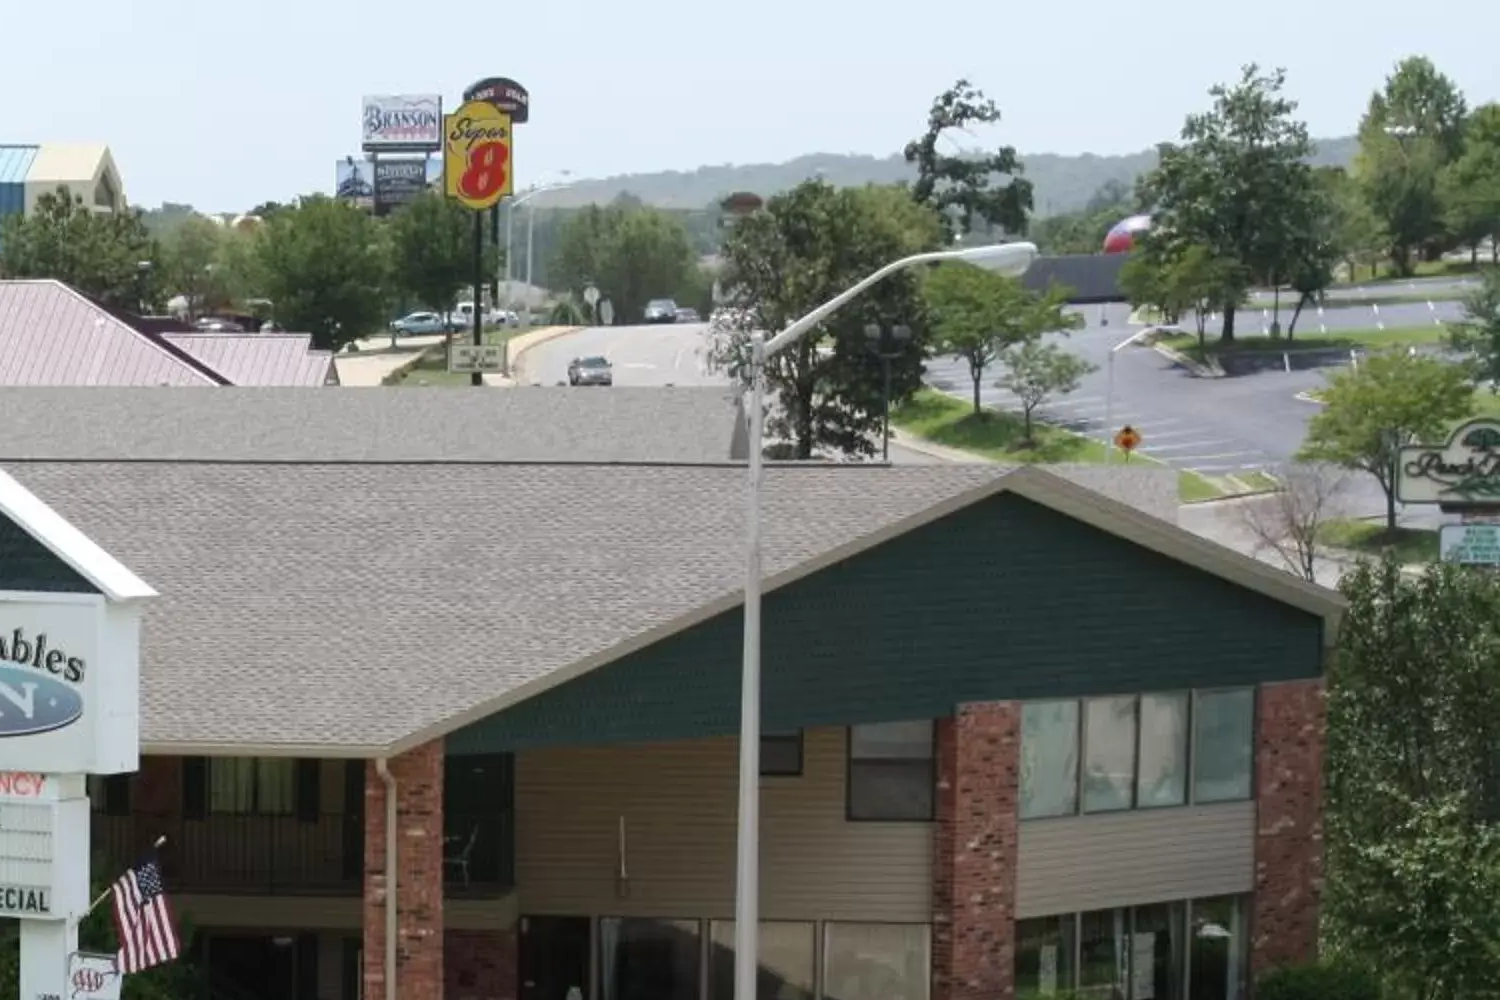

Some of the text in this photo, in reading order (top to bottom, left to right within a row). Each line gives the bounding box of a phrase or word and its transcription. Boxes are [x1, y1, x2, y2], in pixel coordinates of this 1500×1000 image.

[364, 104, 437, 132] BRANSON
[449, 117, 506, 150] Super
[458, 141, 509, 200] 8
